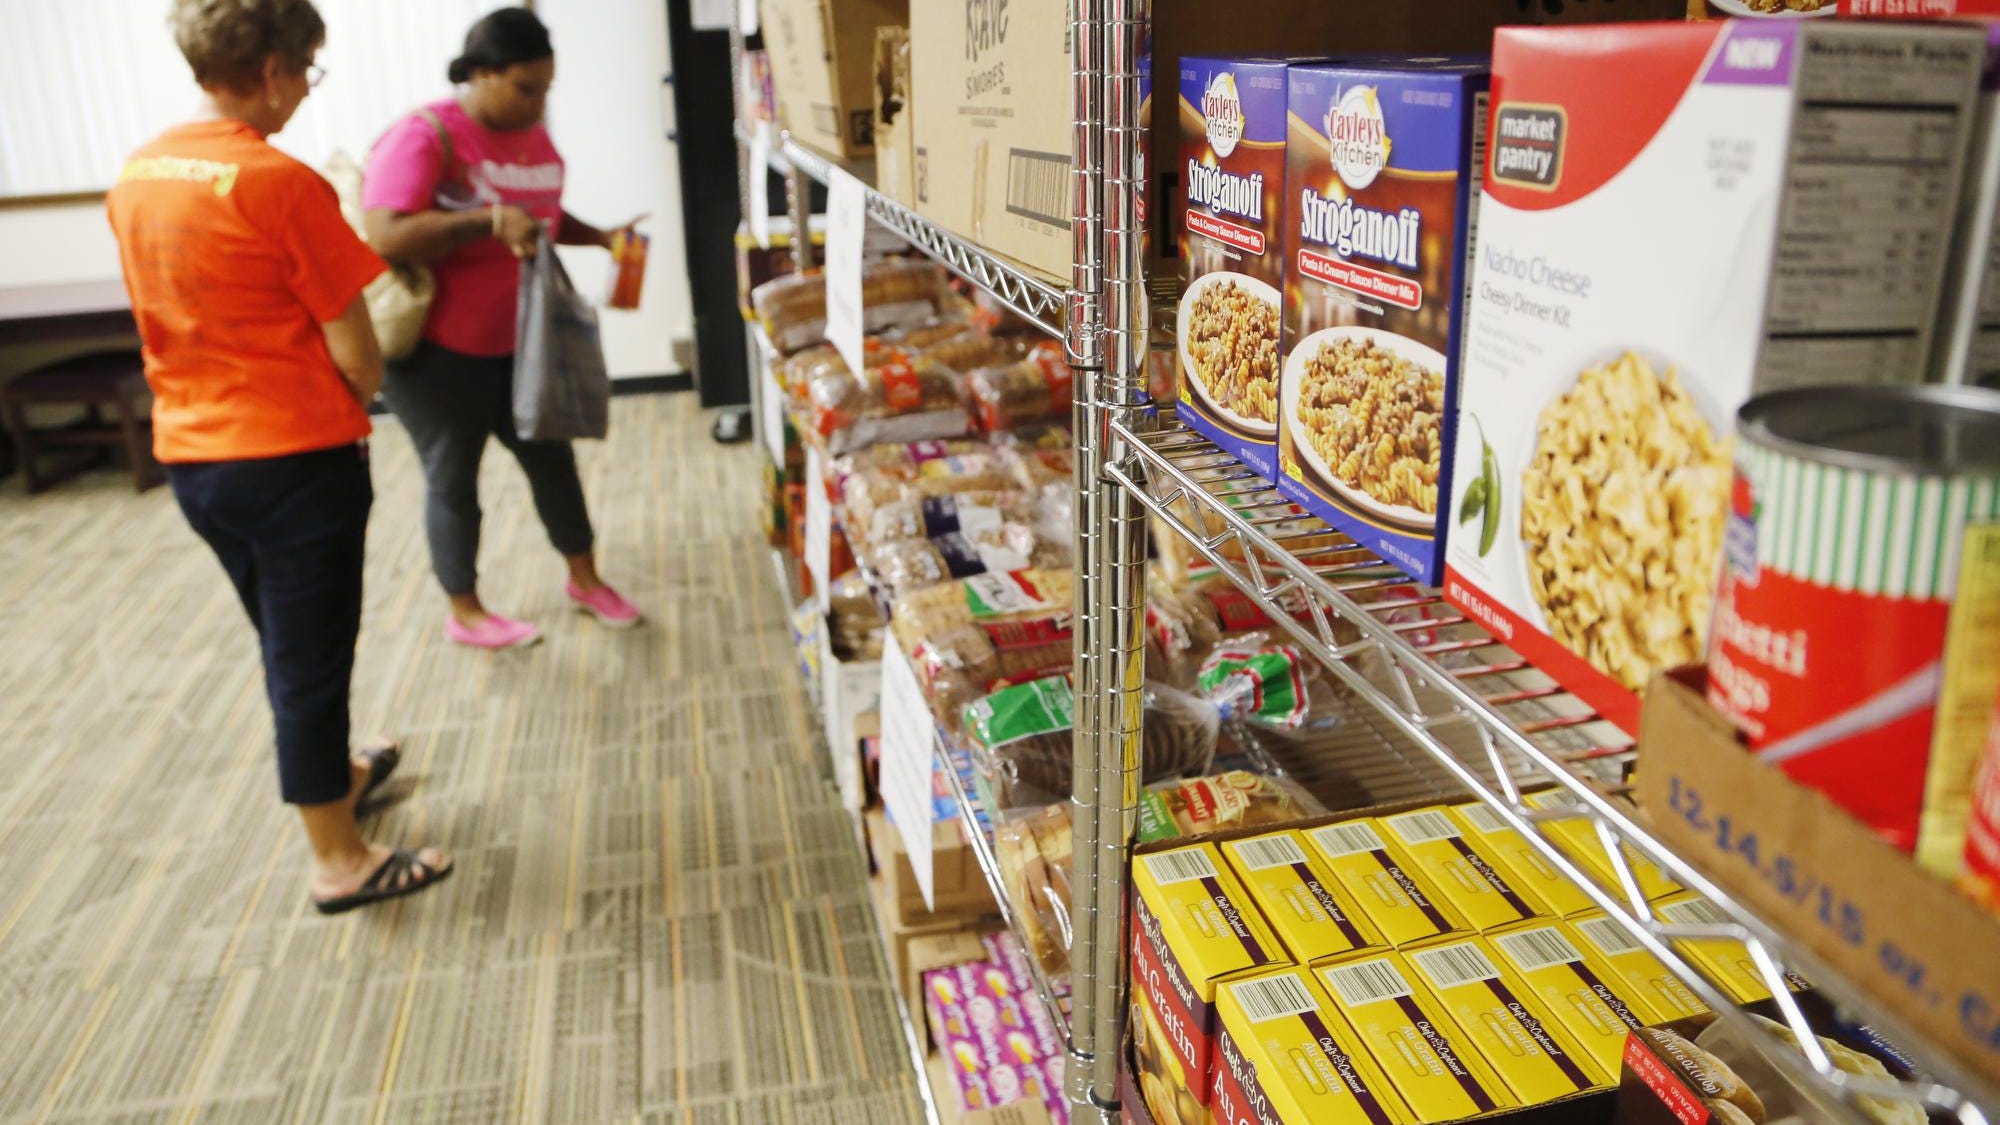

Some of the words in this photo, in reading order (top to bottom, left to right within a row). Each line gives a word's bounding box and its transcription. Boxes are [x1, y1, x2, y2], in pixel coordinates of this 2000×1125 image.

[1722, 37, 1783, 70] NEW
[1502, 114, 1556, 141] market
[1332, 141, 1383, 166] Kitchen
[1498, 146, 1553, 180] pantry
[1188, 158, 1263, 220] Stroganoff
[1301, 188, 1420, 267] Stroganoff
[1302, 255, 1318, 271] Pasta
[1350, 270, 1372, 289] Sauce
[1373, 277, 1399, 296] Dinner
[1399, 284, 1415, 301] Mix
[1484, 243, 1527, 280] Nacho
[1529, 256, 1593, 299] Cheese
[1480, 280, 1513, 315] Cheesy
[1514, 291, 1552, 321] Dinner
[1553, 305, 1572, 329] Kit
[1136, 896, 1153, 941] Chef's
[1160, 944, 1195, 1011] Cupboard
[1133, 932, 1149, 982] Au
[1149, 969, 1197, 1070] Gratin
[1221, 1031, 1243, 1082] Chef's
[1437, 1047, 1467, 1076] Cupboard
[1530, 1027, 1562, 1056] Cupboard
[1651, 1030, 1668, 1047] NET
[1665, 1039, 1681, 1055] WT
[1675, 1052, 1684, 1061] 6
[1682, 1059, 1697, 1070] OZ
[1313, 1058, 1343, 1095] Gratin
[1319, 1037, 1338, 1055] Chef's
[1337, 1064, 1367, 1094] Cupboard
[1214, 1069, 1234, 1125] Au
